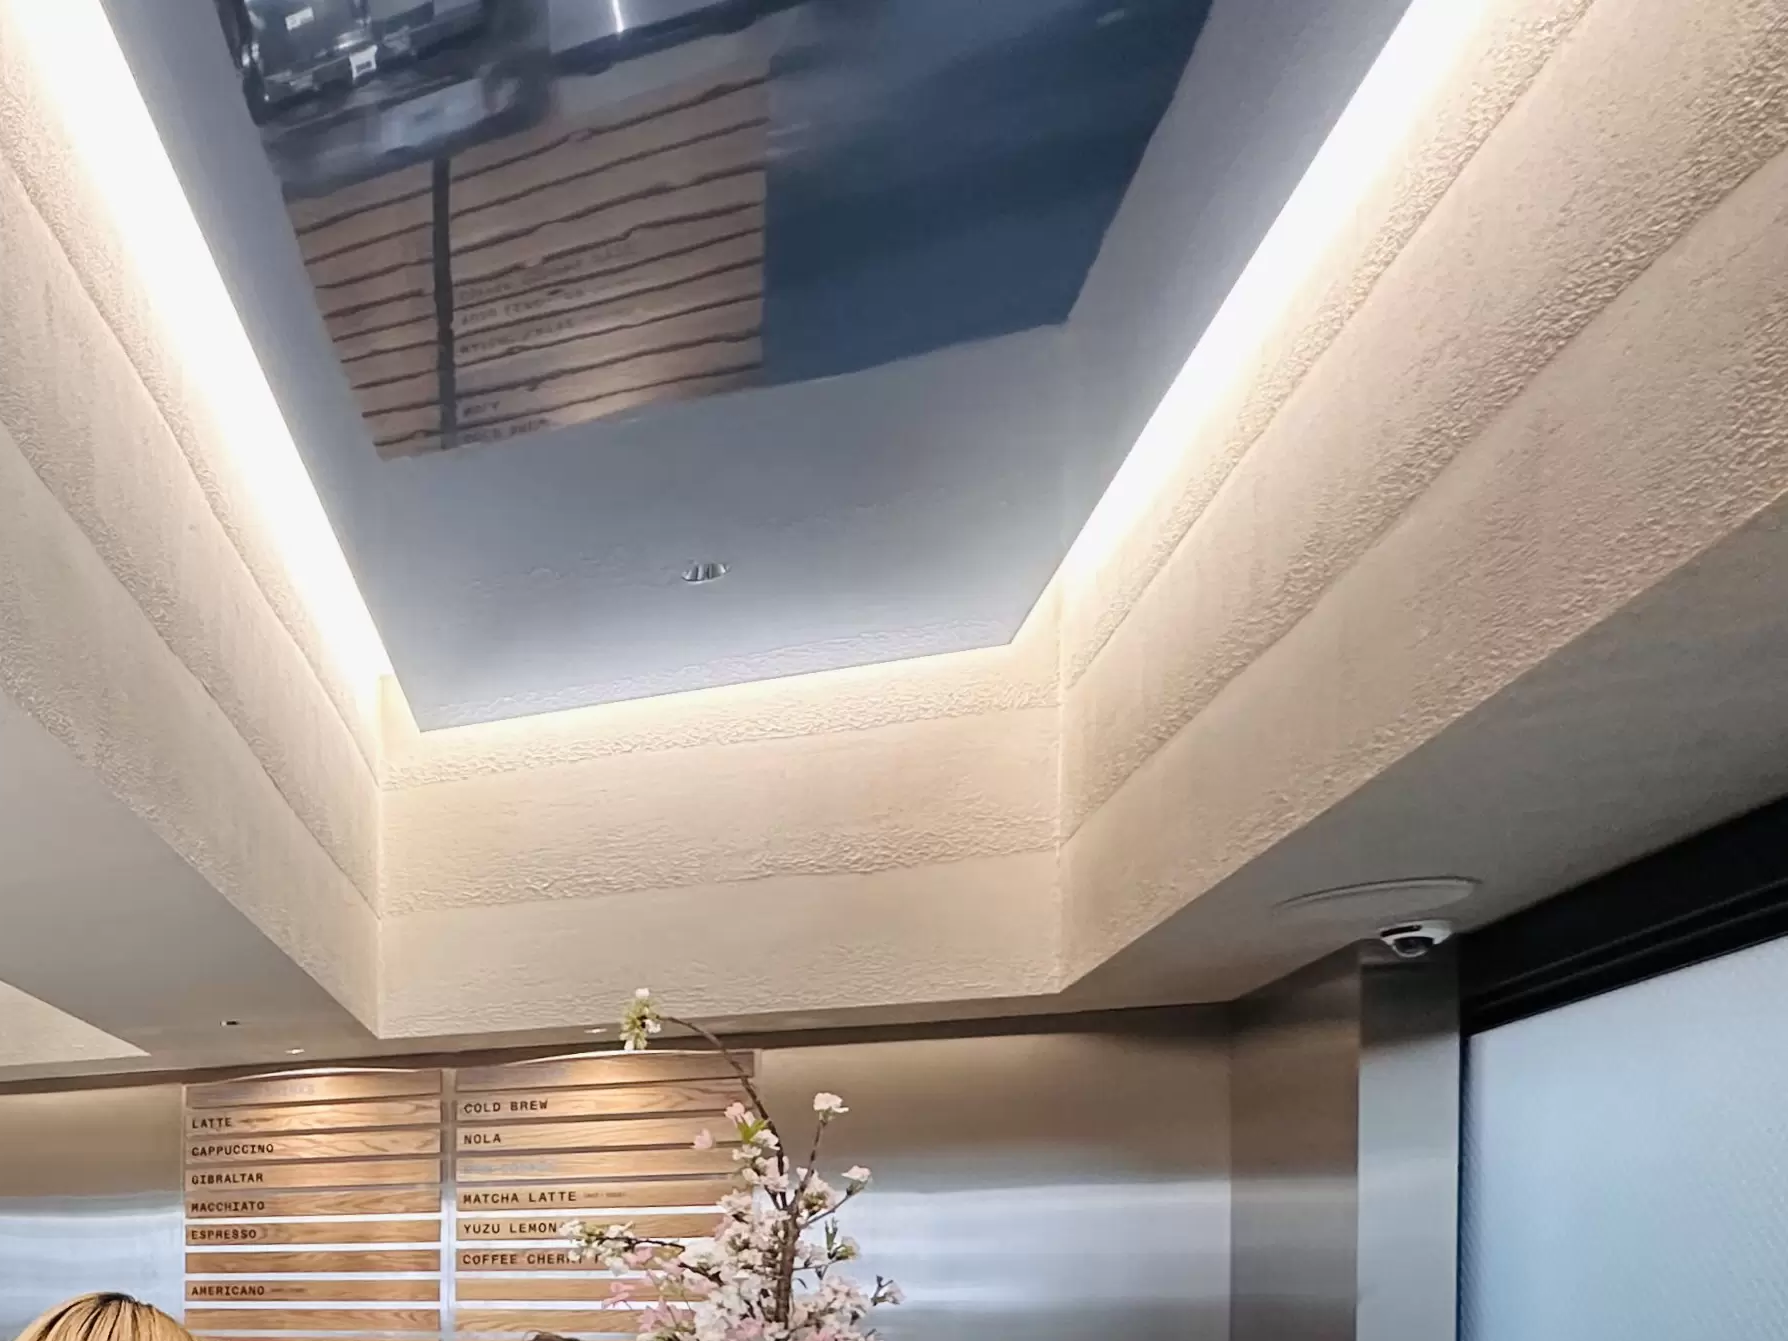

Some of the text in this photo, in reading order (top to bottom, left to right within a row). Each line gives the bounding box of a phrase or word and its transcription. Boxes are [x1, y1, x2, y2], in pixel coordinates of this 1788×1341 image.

[463, 1100, 548, 1114] COLD BREW
[192, 1117, 232, 1129] LATTE
[463, 1133, 501, 1145] NOLA
[191, 1144, 274, 1157] CAPPUCCINO
[191, 1172, 263, 1185] GIBRALTAR
[463, 1193, 520, 1205] MATCHA
[528, 1191, 577, 1203] LATTE
[191, 1201, 265, 1213] MACCHIATO
[464, 1222, 557, 1234] YUZU LEMON
[191, 1229, 257, 1240] ESPRESSO
[462, 1254, 518, 1265] COFFEE
[191, 1285, 265, 1296] AMERICANO
